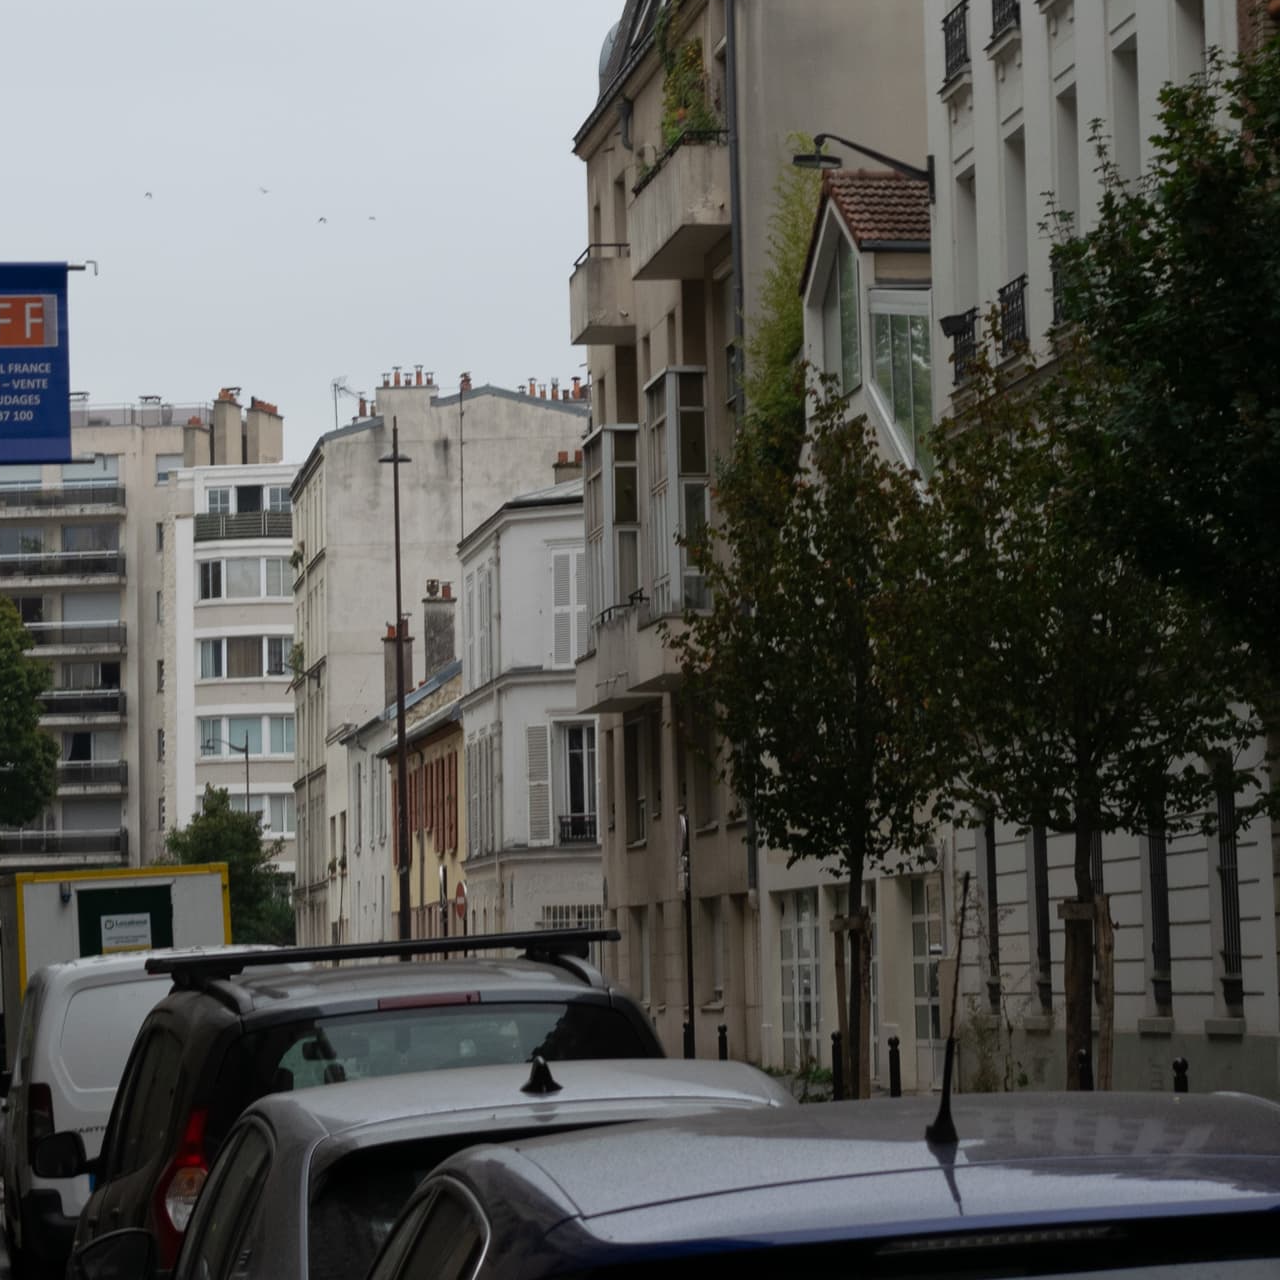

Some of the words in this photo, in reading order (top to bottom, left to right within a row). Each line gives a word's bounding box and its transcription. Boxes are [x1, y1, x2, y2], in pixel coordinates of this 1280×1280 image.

[8, 362, 52, 374] FRANCE
[12, 379, 49, 390] VENTE
[13, 410, 34, 421] 100
